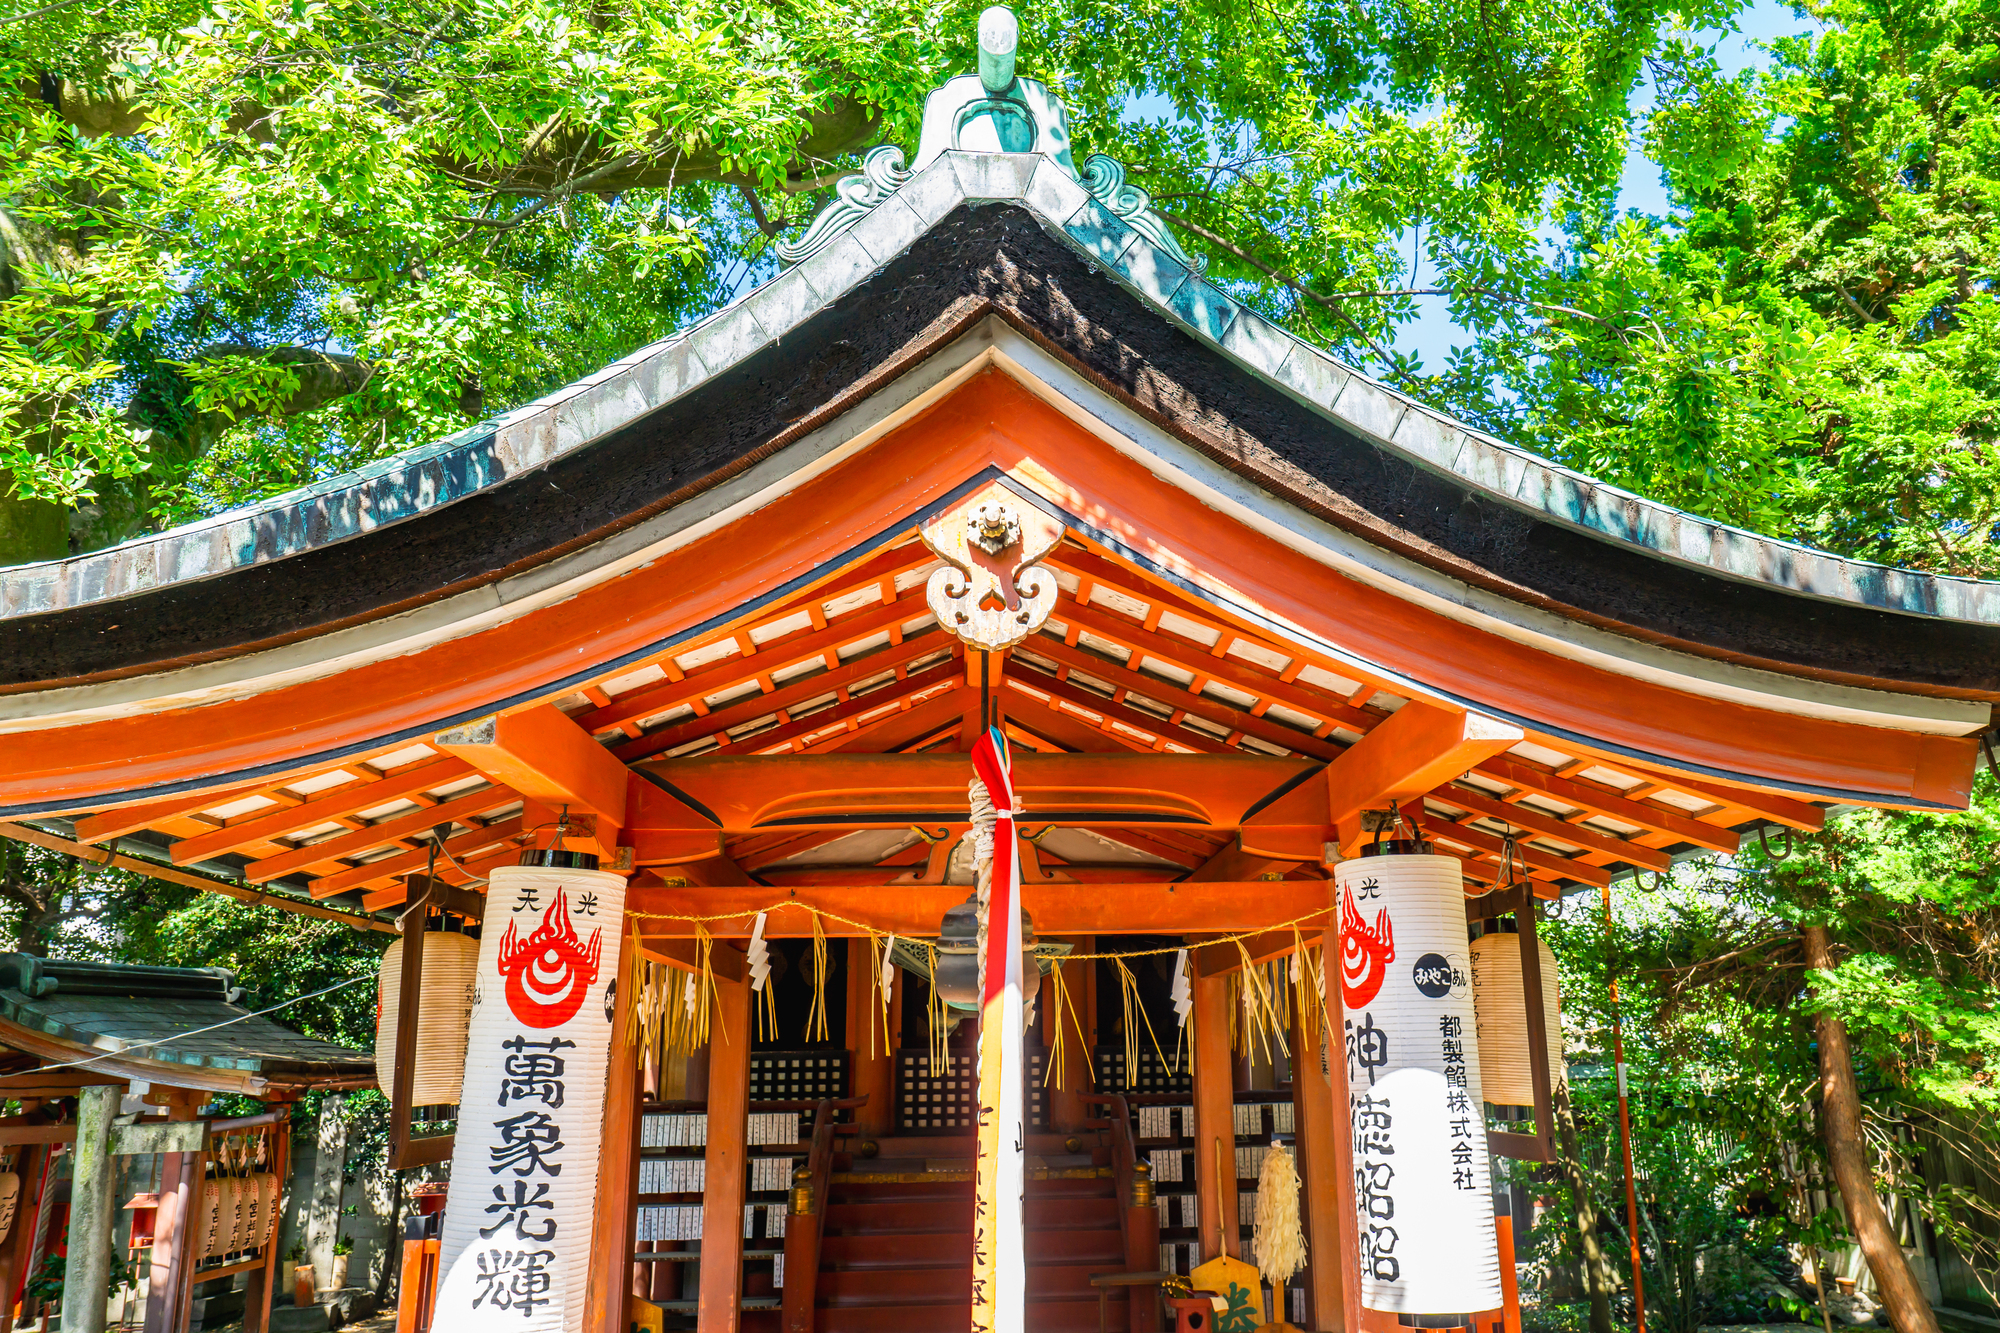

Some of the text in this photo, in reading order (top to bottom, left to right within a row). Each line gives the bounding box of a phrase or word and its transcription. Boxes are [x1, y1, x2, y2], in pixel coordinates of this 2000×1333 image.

[513, 888, 598, 916] 天 光
[1357, 877, 1382, 901] 光
[1439, 1014, 1476, 1191] 都製餡株式会社
[472, 1034, 576, 1318] 萬象光輝
